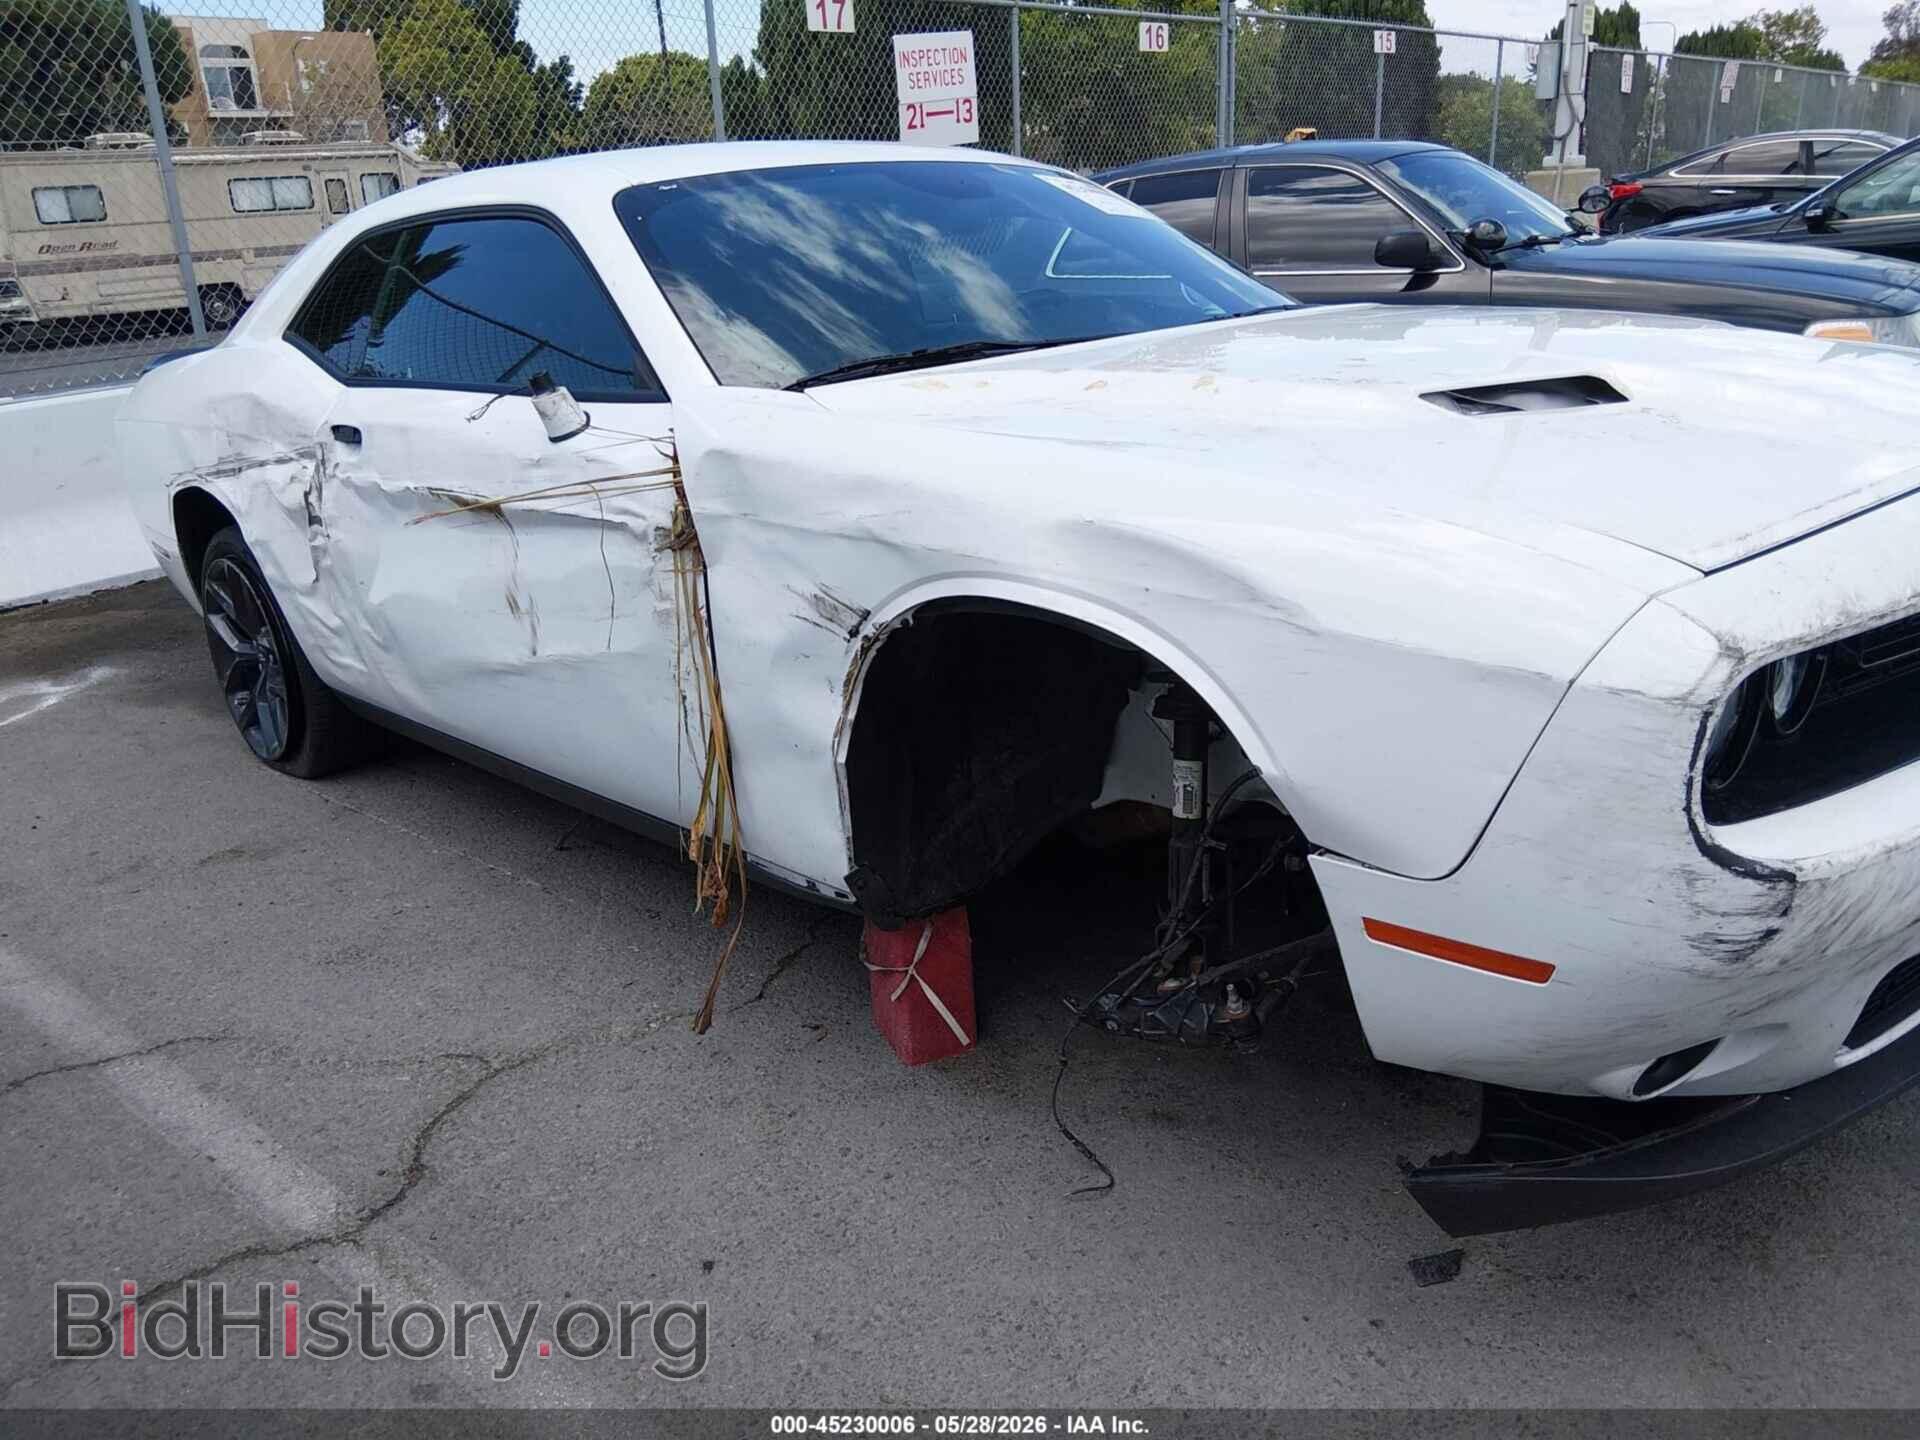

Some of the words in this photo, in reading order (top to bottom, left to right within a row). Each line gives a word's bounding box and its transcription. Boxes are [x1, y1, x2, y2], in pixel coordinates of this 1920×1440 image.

[816, 0, 845, 29] 17
[1145, 24, 1164, 49] 16
[1379, 32, 1392, 51] 15
[899, 47, 967, 68] INSPECTION
[908, 68, 965, 89] SERVICES
